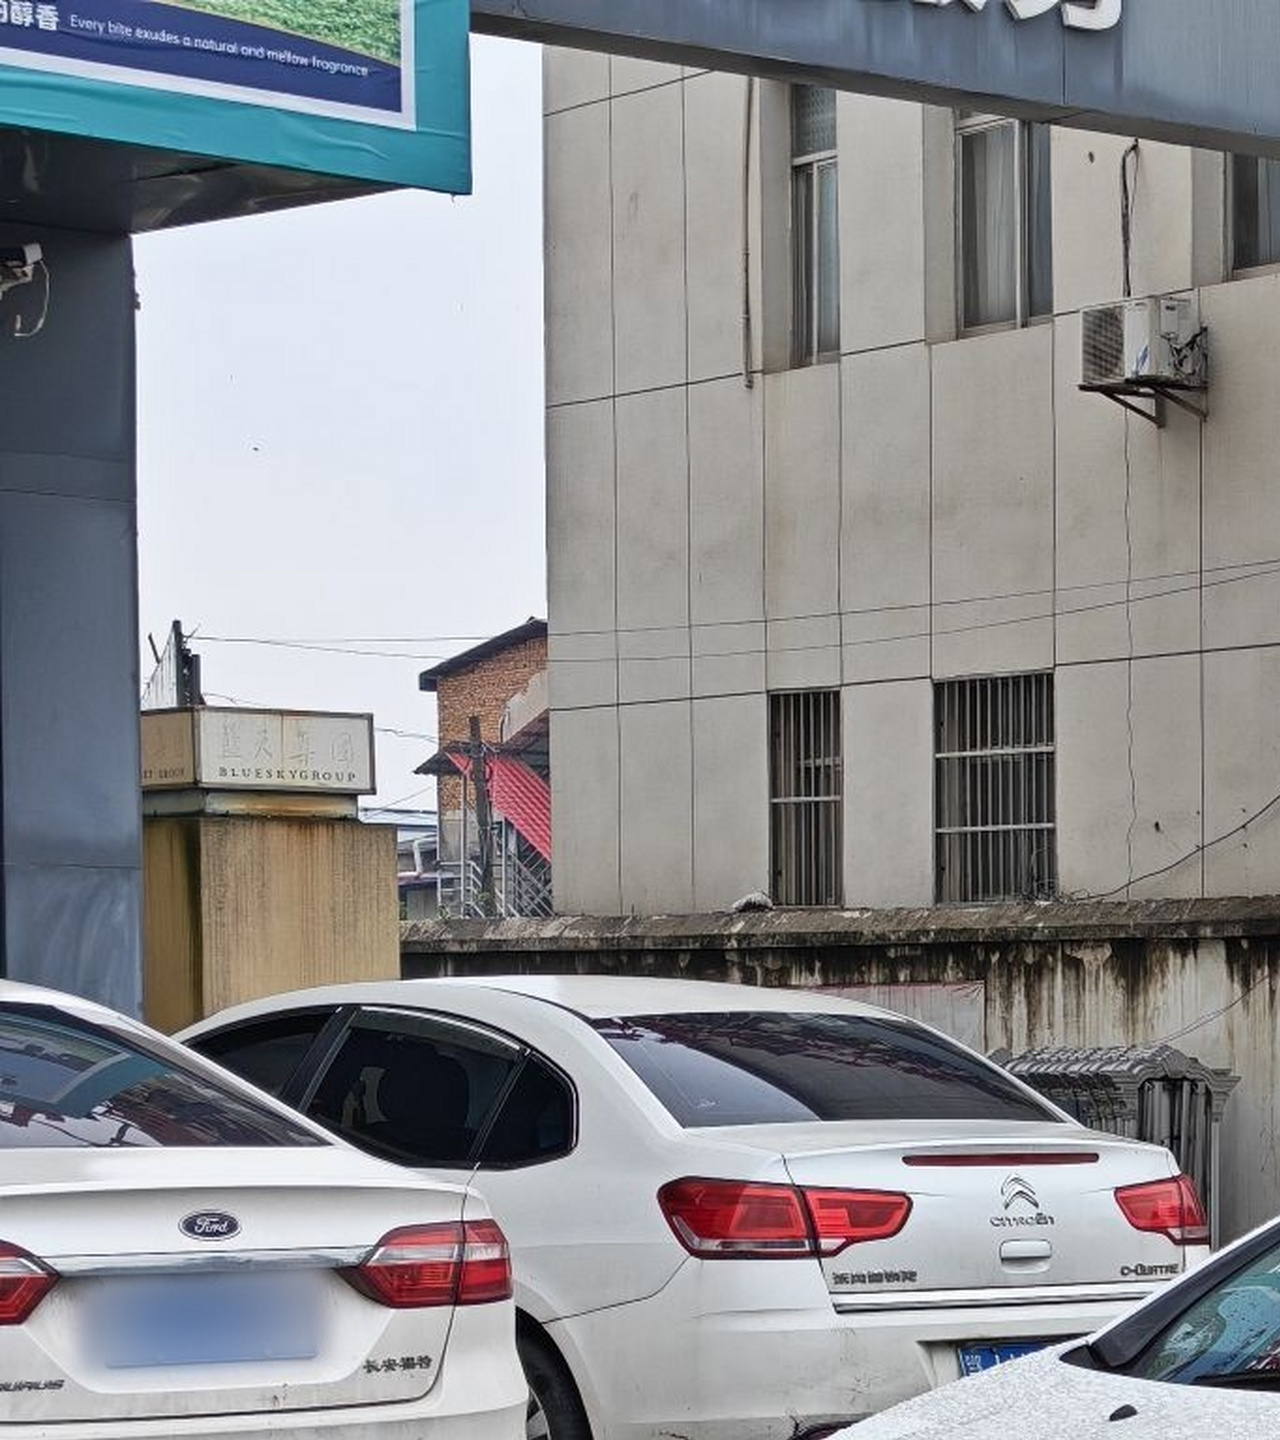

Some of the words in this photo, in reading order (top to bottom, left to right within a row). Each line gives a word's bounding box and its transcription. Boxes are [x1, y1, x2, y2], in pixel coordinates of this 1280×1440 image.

[70, 14, 104, 34] Every
[108, 22, 132, 36] bite
[135, 28, 180, 45] exudes
[182, 36, 192, 47] a
[194, 38, 237, 54] natural
[241, 45, 265, 58] and
[267, 49, 309, 66] mellow
[312, 56, 369, 77] fragrance
[194, 1216, 229, 1233] Ford
